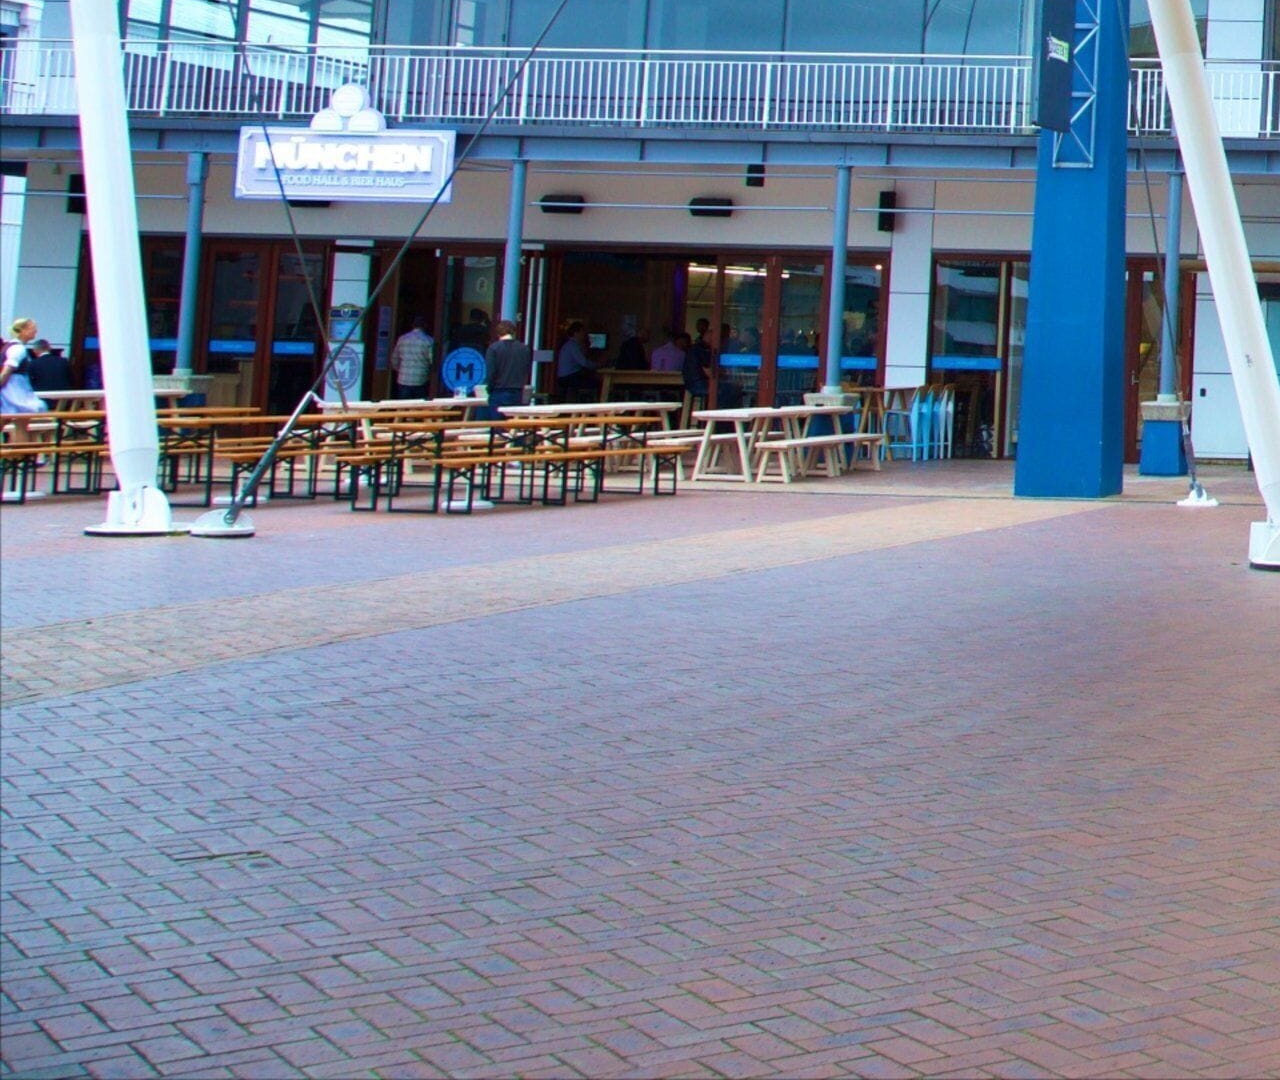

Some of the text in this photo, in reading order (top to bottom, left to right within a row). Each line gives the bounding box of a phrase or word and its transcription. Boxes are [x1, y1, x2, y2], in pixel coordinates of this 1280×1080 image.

[283, 175, 313, 186] FOOD
[313, 175, 340, 186] HALL
[376, 176, 405, 188] HAUS
[456, 362, 474, 381] M
